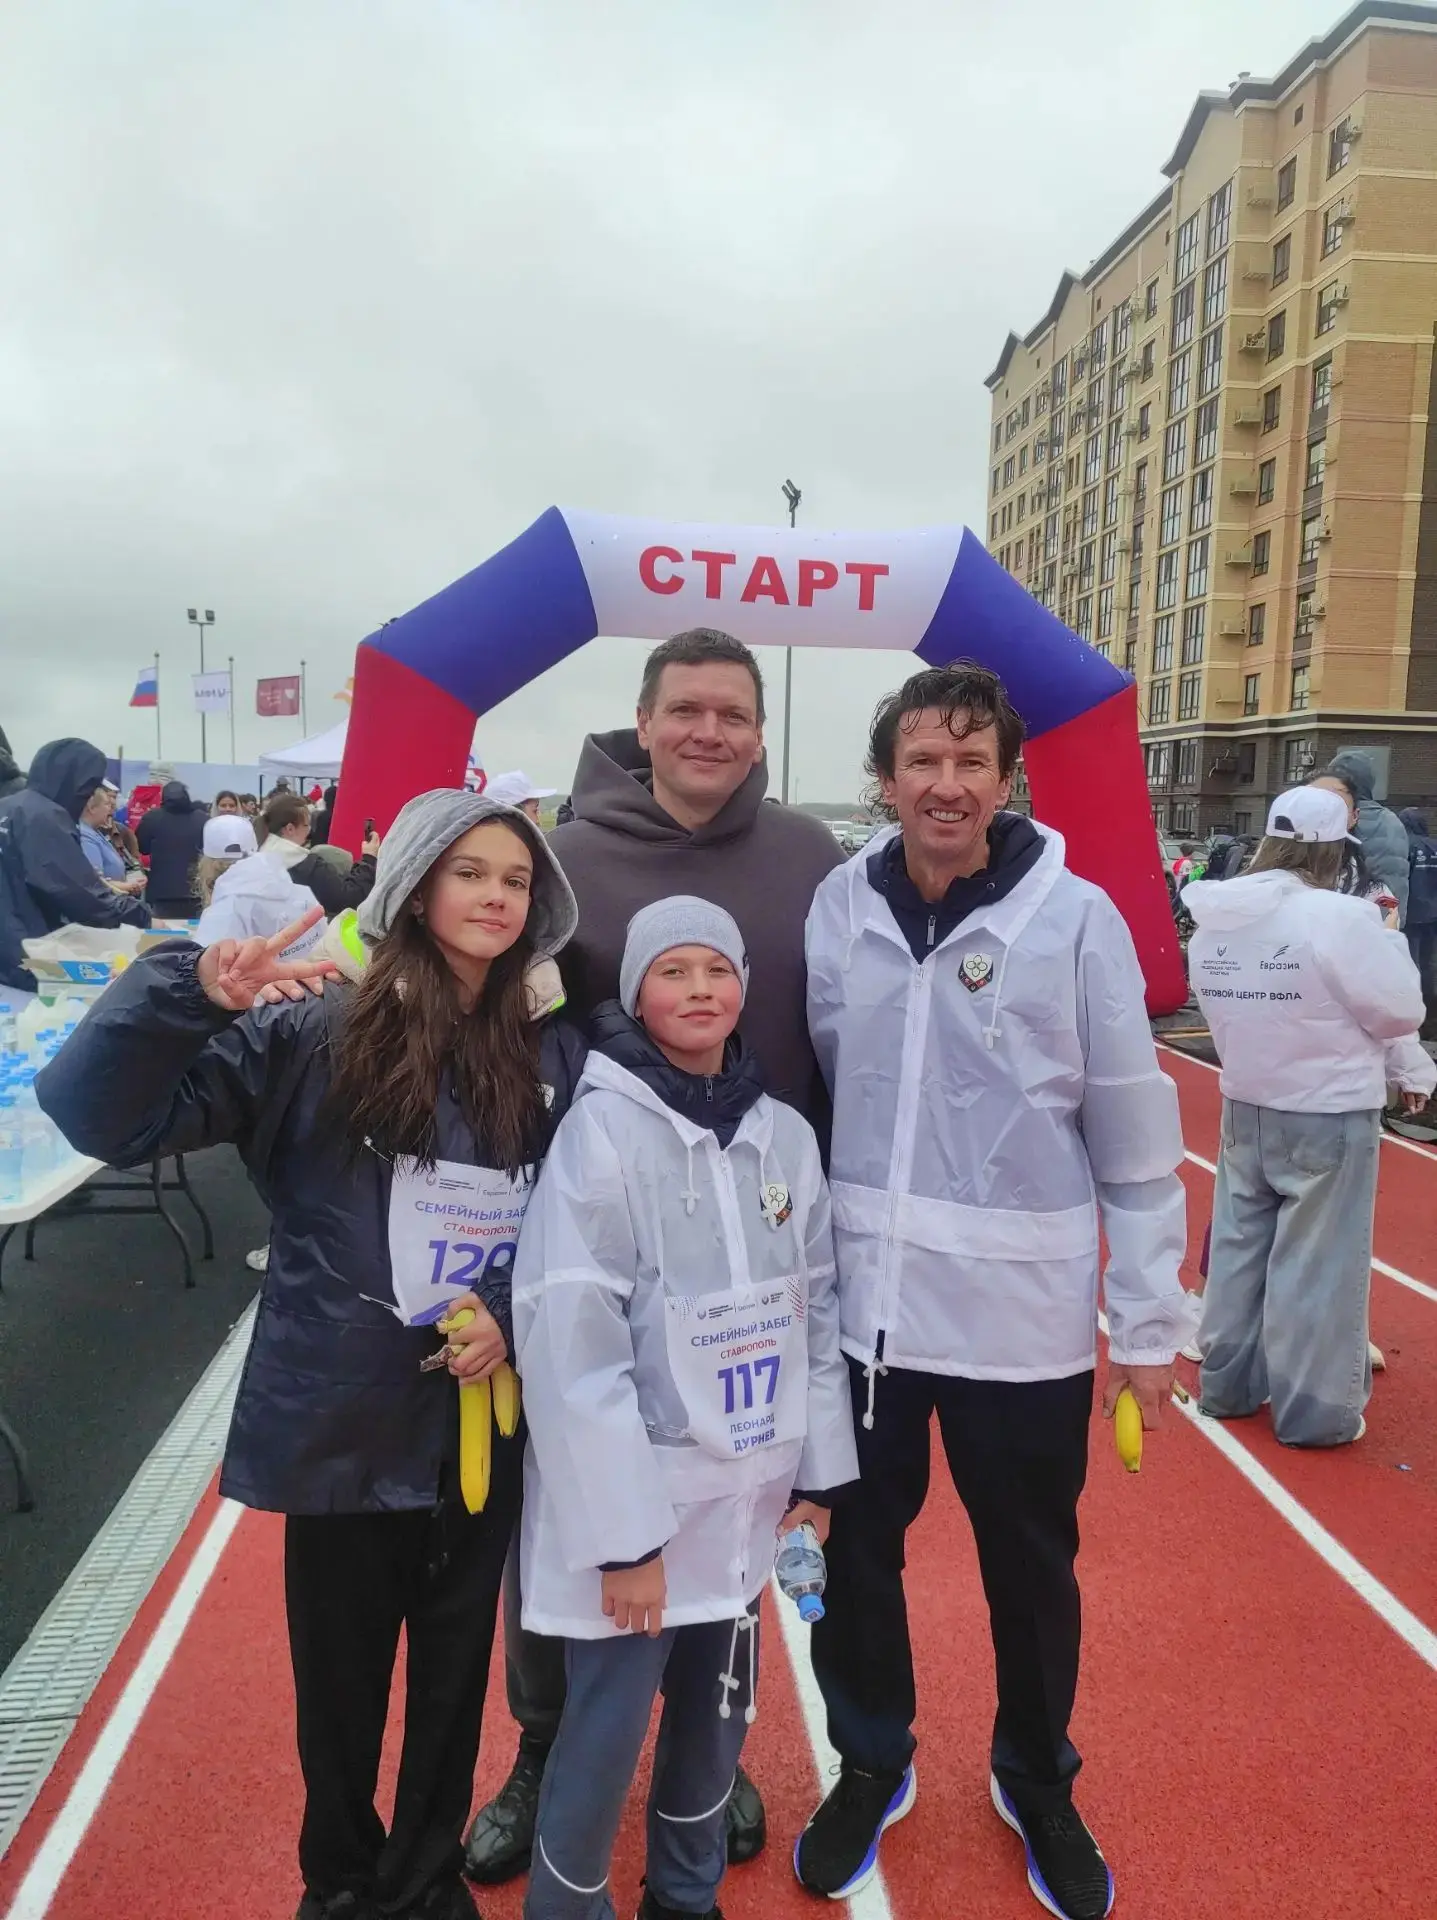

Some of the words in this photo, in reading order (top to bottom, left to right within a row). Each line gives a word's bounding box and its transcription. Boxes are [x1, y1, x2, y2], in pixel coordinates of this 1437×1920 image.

[639, 545, 890, 611] СТАРТ
[1259, 960, 1300, 972] Евразия
[1236, 991, 1267, 1001] ЦЕНТР
[1269, 992, 1302, 1001] ВФЛА
[415, 1200, 503, 1221] СЕМЕЙНЫЙ
[504, 1206, 527, 1218] ЗАБ
[443, 1222, 518, 1236] СТАВРОПОЛЬ
[690, 1320, 758, 1347] СЕМЕЙНЫЙ
[760, 1315, 793, 1333] ЗАБЕГ
[720, 1338, 777, 1360] СТАВРОПОЛЬ
[717, 1355, 781, 1414] 117
[730, 1412, 775, 1434] ЛЕОНАРД
[733, 1428, 776, 1453] ДУРНЕВ
